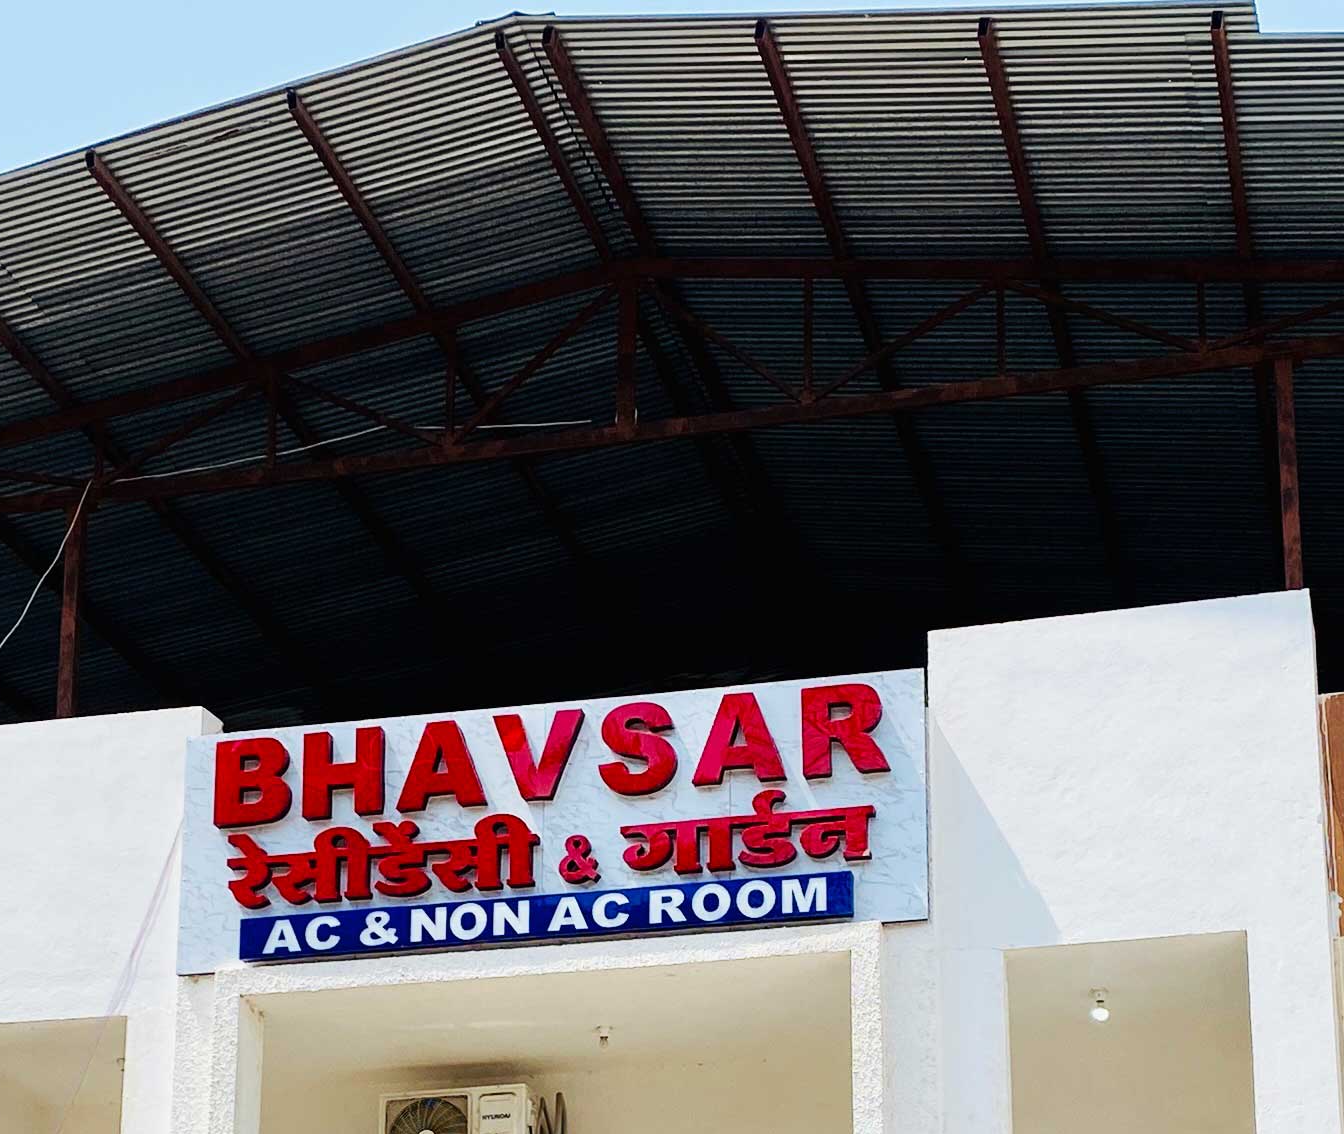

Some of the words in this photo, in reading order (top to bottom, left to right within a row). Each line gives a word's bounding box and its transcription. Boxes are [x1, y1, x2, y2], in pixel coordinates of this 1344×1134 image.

[213, 683, 890, 829] BHAVSAR
[558, 834, 600, 884] &
[620, 787, 877, 875] गार्डन
[262, 915, 341, 955] AC
[359, 911, 399, 946] &
[410, 900, 531, 943] NON
[547, 892, 630, 932] AC
[649, 877, 828, 924] ROOM
